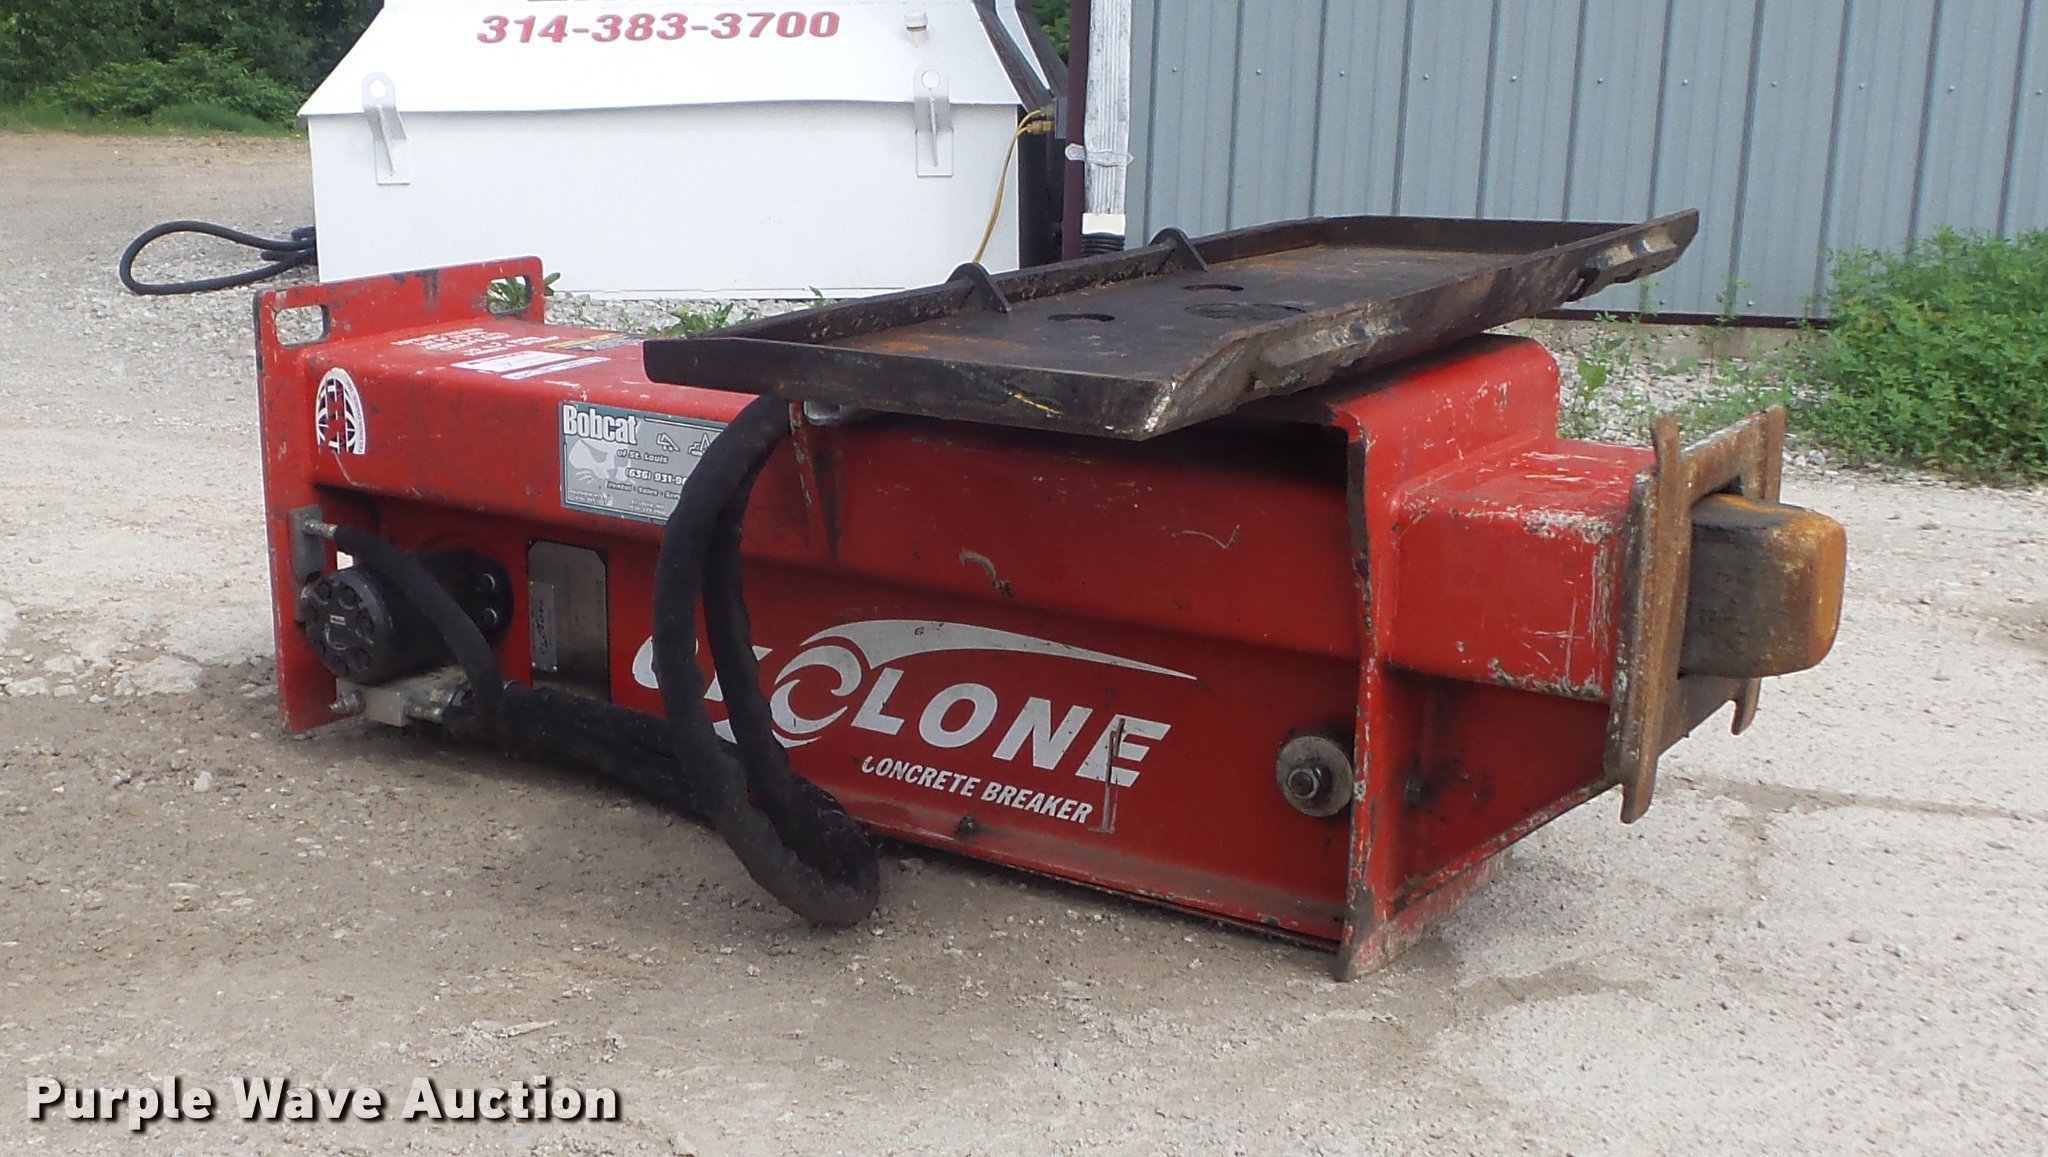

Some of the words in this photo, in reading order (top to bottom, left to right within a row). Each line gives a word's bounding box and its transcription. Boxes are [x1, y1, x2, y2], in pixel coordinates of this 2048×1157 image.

[477, 11, 840, 43] 314-383-3700
[563, 404, 637, 445] Bobcat
[617, 448, 628, 458] of
[643, 453, 669, 464] Louis
[625, 468, 652, 480] (636)
[632, 636, 1171, 788] CLONE
[862, 756, 980, 797] CONCRETE
[981, 781, 1093, 824] BREAKER
